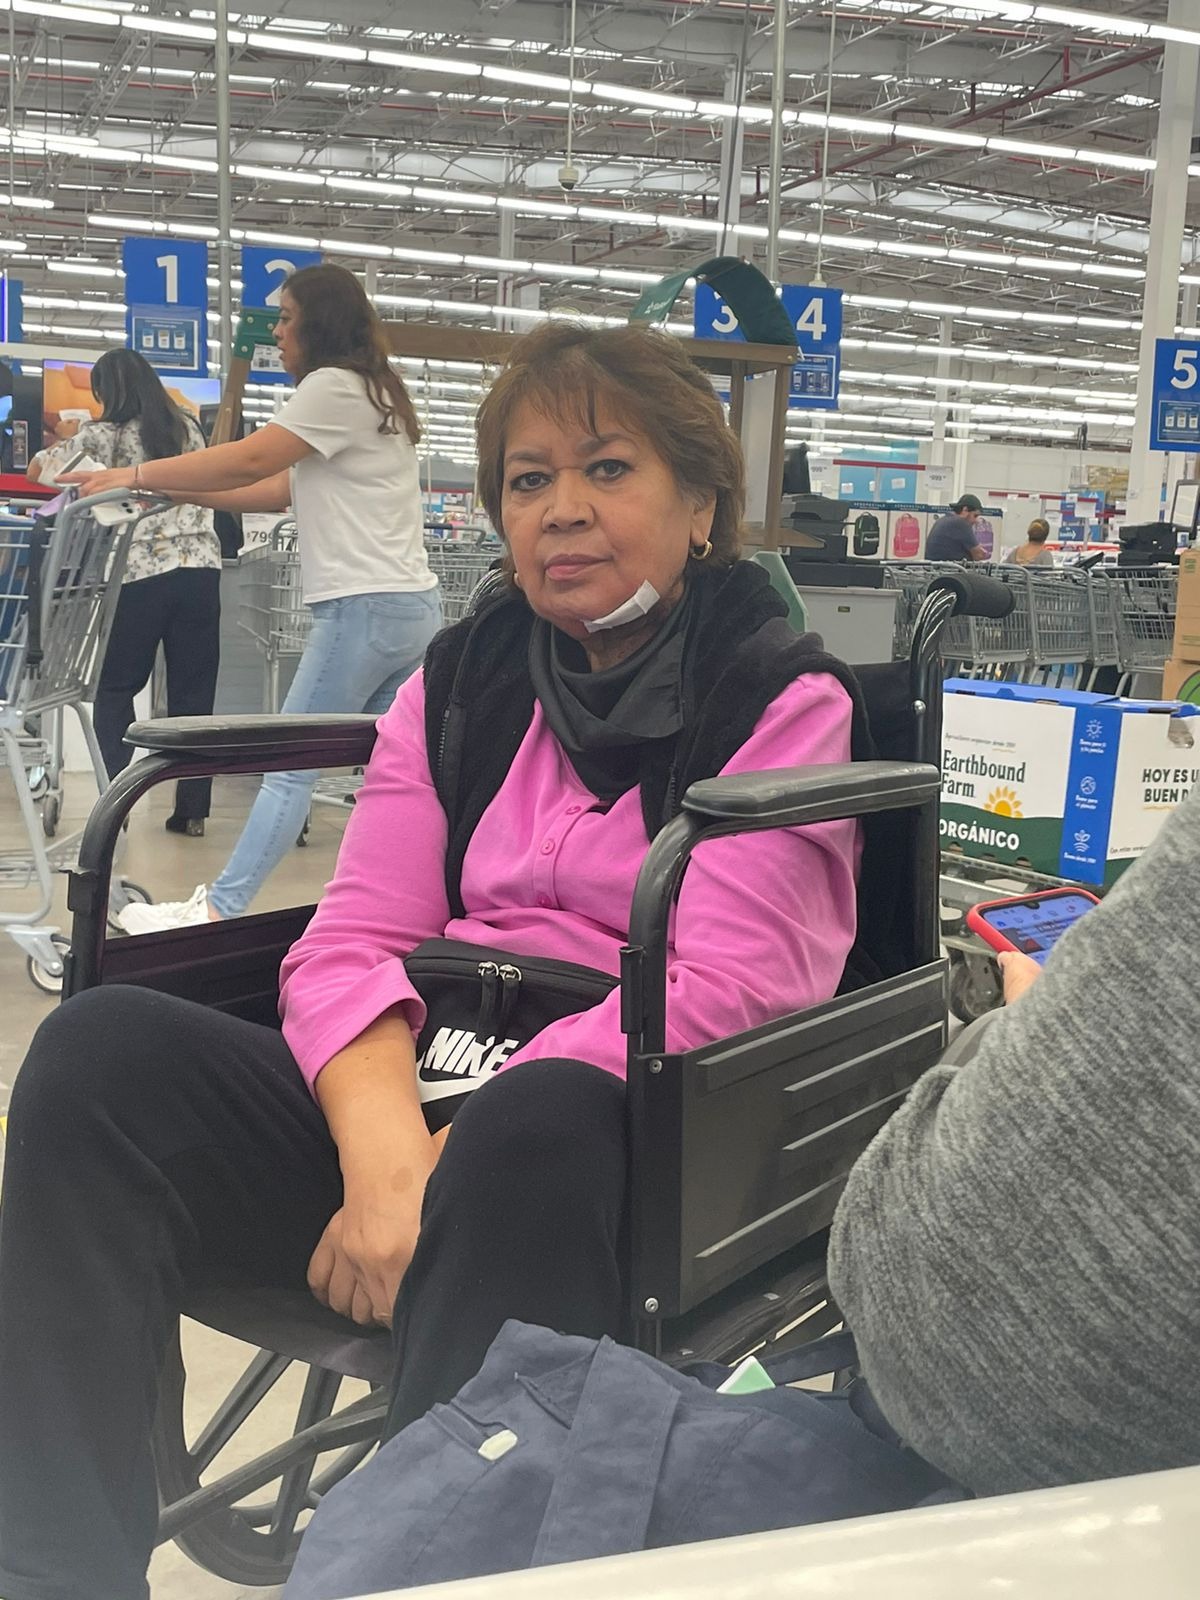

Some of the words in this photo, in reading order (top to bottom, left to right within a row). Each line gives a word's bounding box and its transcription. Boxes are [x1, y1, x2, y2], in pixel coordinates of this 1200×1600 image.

[156, 255, 179, 303] 1
[264, 258, 297, 306] 2
[796, 297, 827, 341] 4
[1170, 349, 1198, 389] 5
[943, 749, 1026, 783] Earthbound
[1142, 769, 1171, 783] HOY
[1173, 769, 1188, 783] ES
[941, 773, 975, 798] Farm
[1144, 788, 1179, 802] BUEN
[938, 820, 1020, 850] ORGÁNICO
[424, 1026, 520, 1077] NIKE
